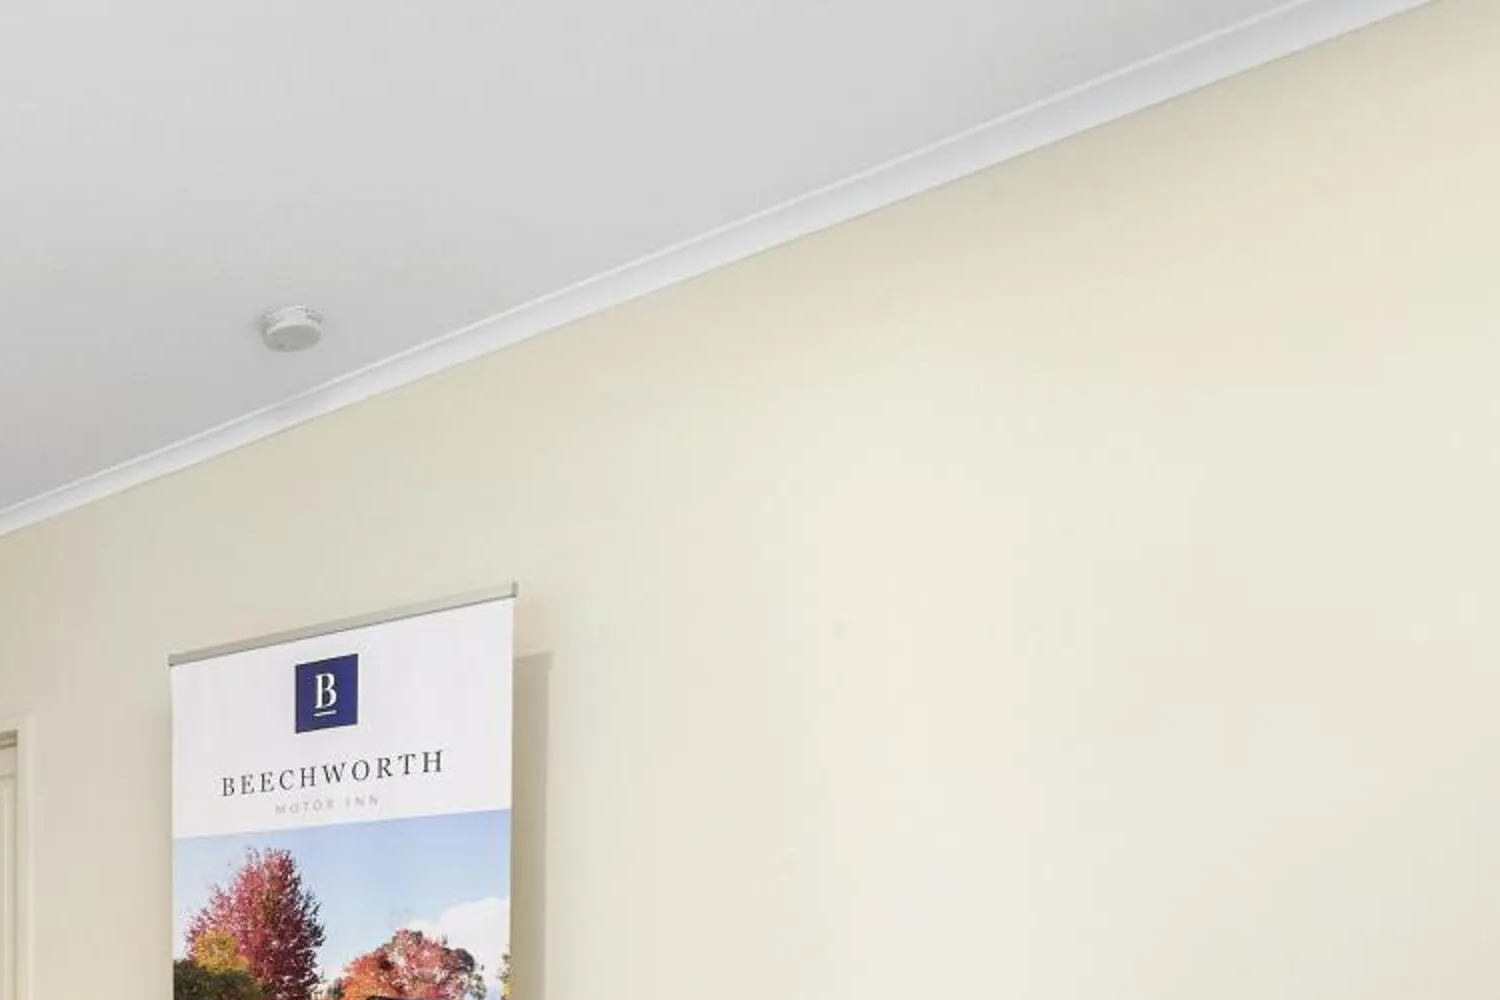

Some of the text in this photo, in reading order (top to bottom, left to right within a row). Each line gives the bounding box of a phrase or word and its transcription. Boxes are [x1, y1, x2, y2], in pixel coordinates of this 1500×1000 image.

[315, 673, 337, 709] B
[222, 749, 444, 797] BEECHWORTH
[275, 794, 380, 816] MOTOR INN
